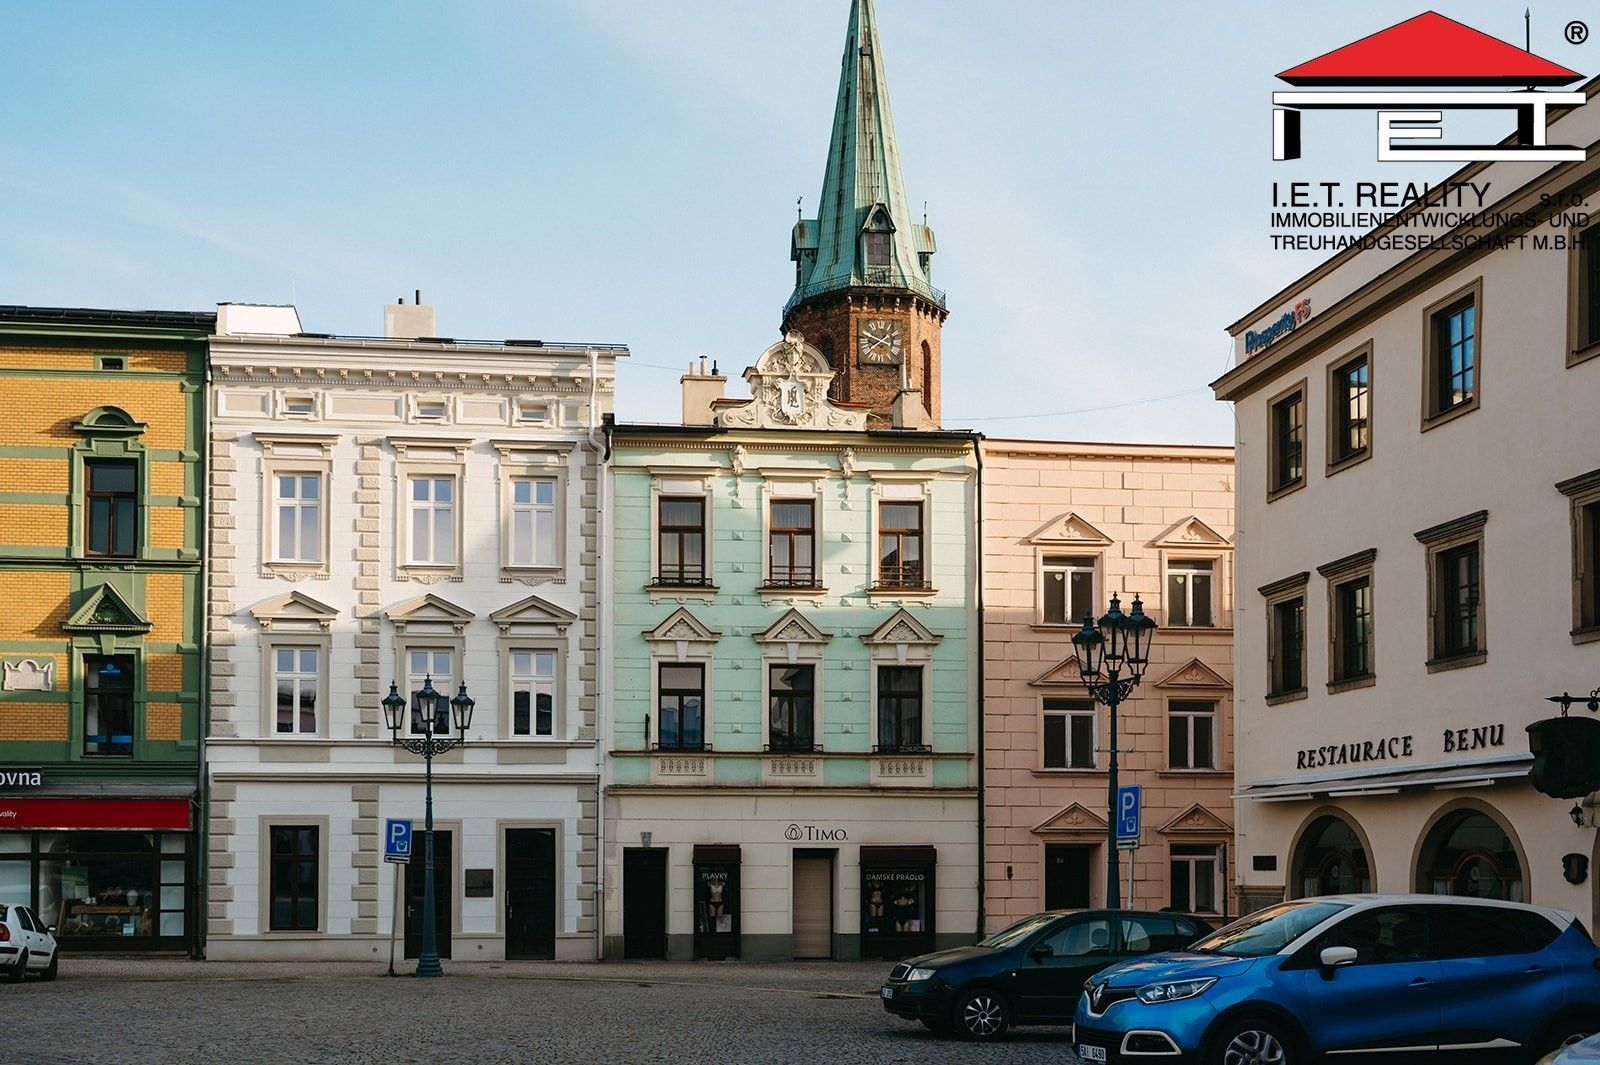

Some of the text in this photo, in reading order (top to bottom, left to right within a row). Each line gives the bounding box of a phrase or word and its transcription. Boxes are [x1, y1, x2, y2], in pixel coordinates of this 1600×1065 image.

[1297, 723, 1505, 769] RESTAURACE BENU
[1122, 792, 1135, 822] P
[391, 823, 406, 844] P
[702, 872, 728, 880] PLAVKY
